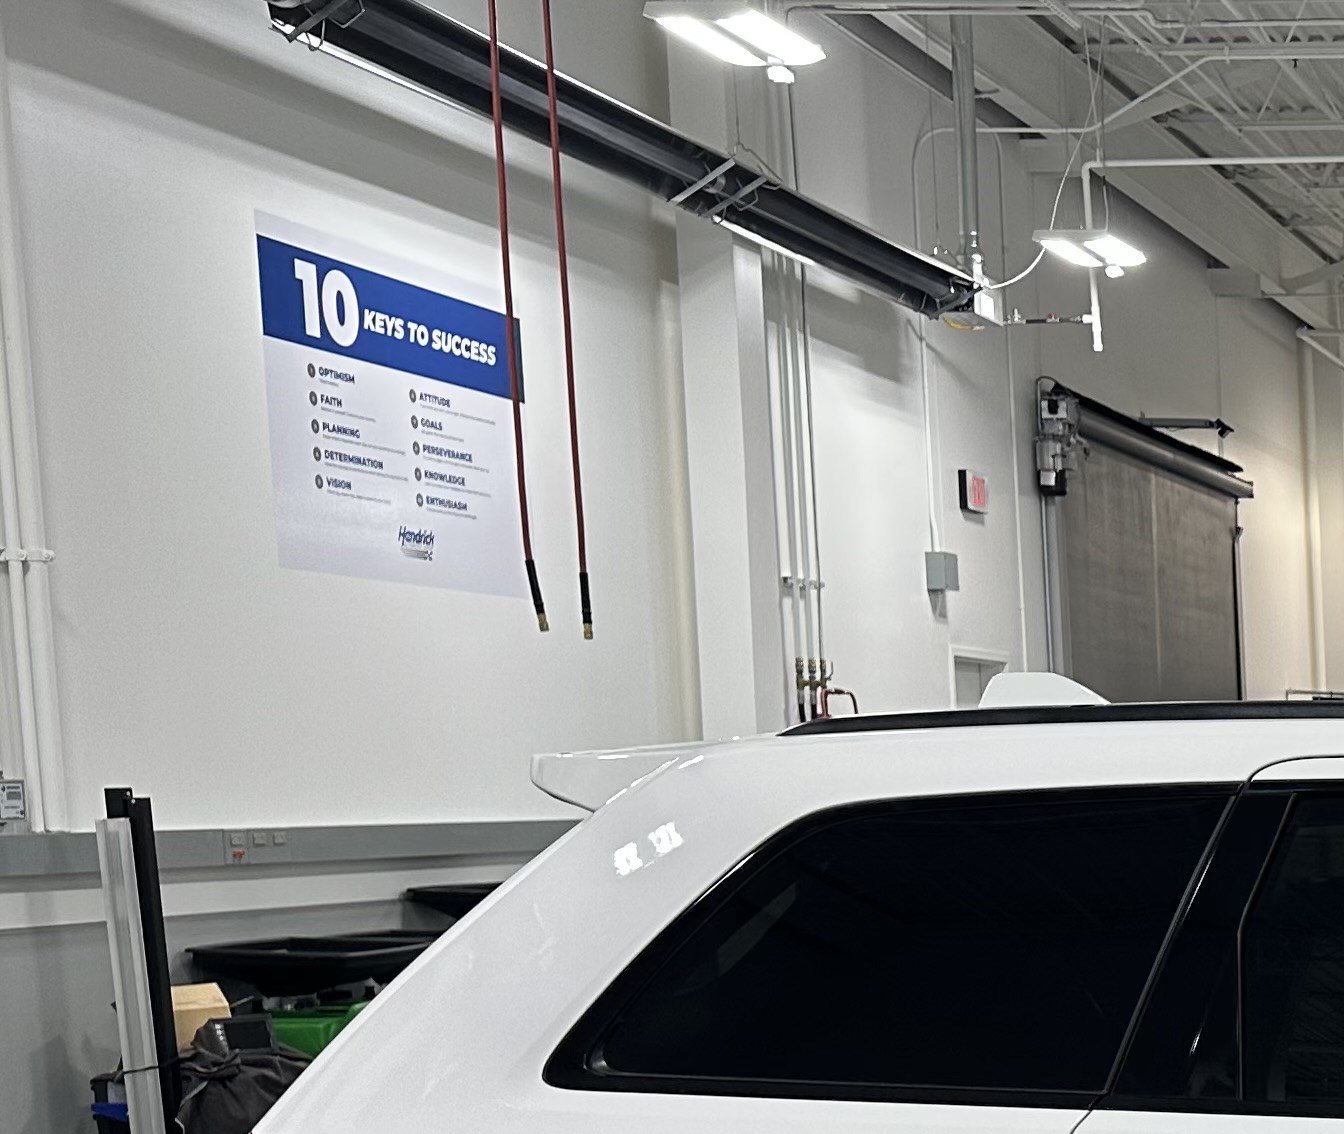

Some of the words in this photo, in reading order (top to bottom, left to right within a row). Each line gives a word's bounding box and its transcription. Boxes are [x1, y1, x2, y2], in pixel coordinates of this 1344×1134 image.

[294, 257, 359, 347] 10
[363, 308, 405, 340] KEYS
[407, 321, 429, 346] TO
[431, 329, 497, 366] SUCCESS
[318, 366, 355, 384] OPTIMISM
[320, 393, 343, 408] FAITH
[419, 392, 451, 408] ATTITUDE
[322, 421, 360, 439] PLANNING
[420, 417, 443, 431] GOALS
[324, 449, 384, 470] DETERMINATION
[422, 443, 473, 463] PERSEVERANCE
[326, 476, 352, 490] VISION
[424, 469, 466, 486] KNOWLEDGE
[426, 495, 468, 511] ENTHUSIASM
[398, 524, 435, 547] Hendrick
